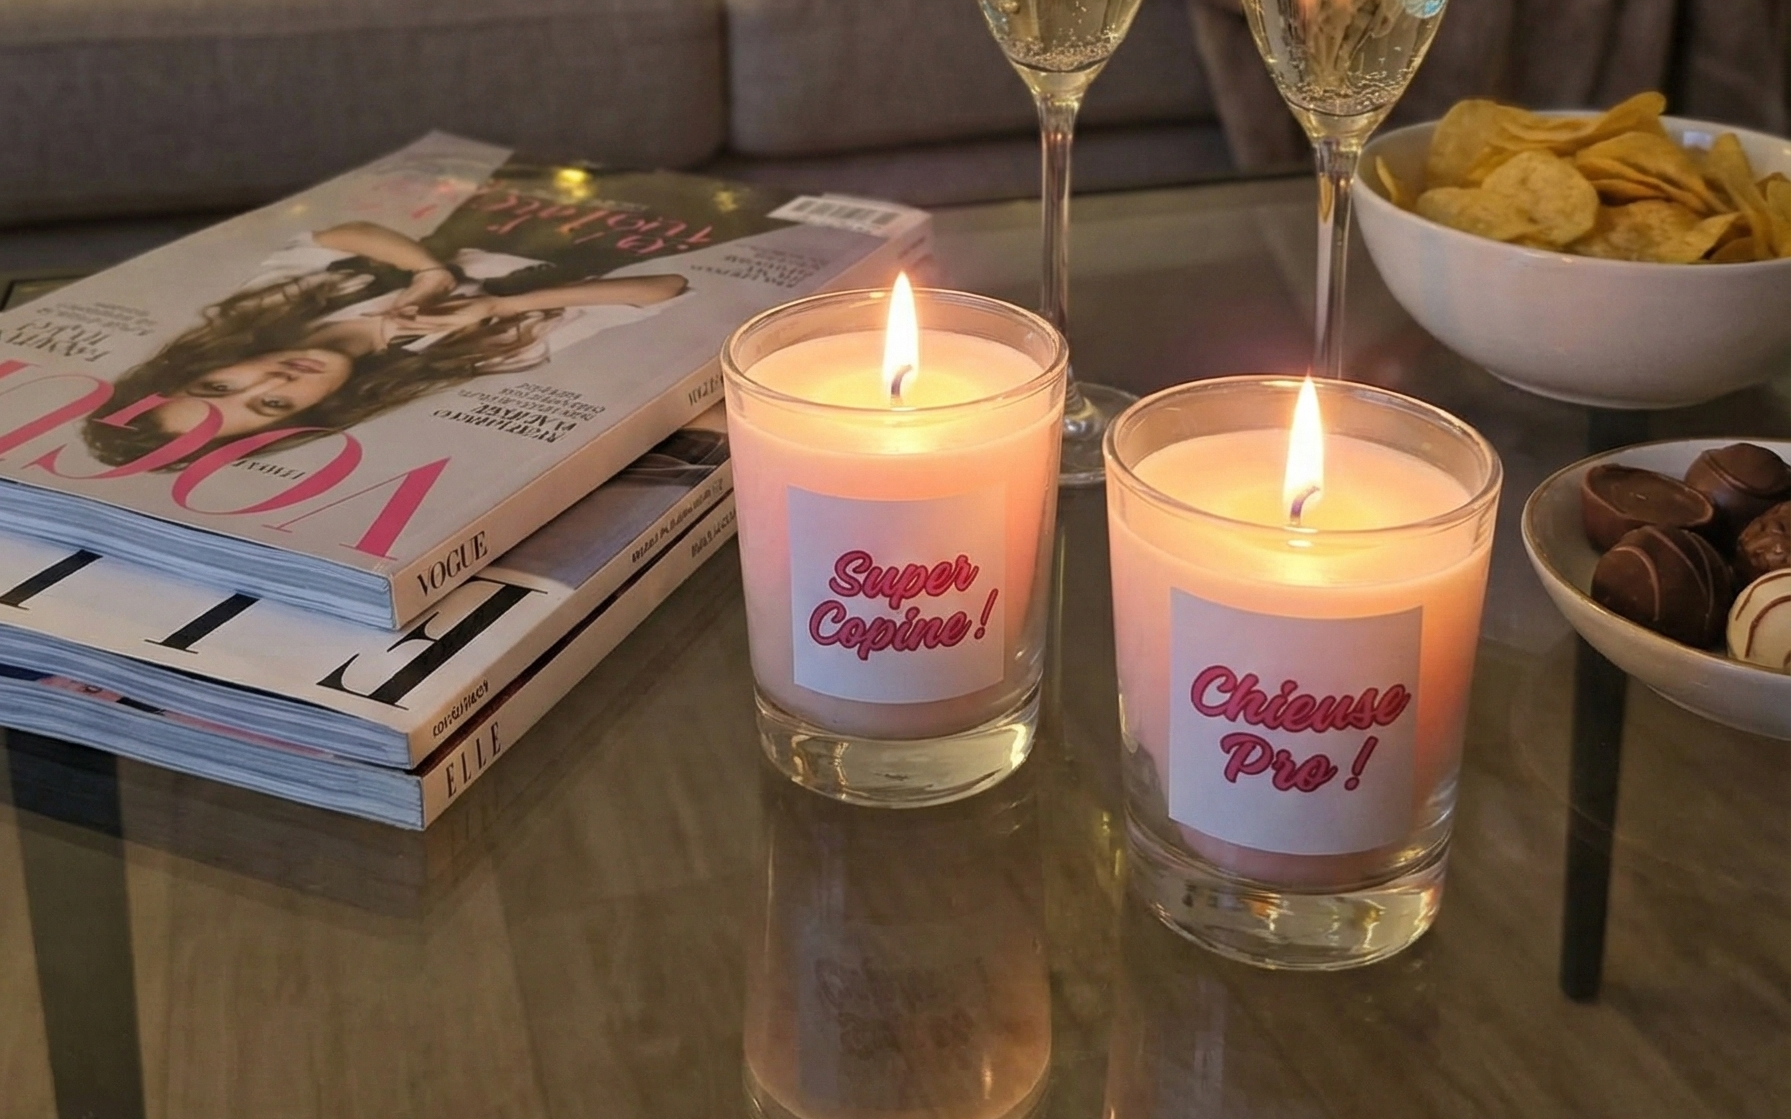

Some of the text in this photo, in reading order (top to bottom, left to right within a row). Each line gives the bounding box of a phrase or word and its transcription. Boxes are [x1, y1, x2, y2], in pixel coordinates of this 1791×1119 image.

[0, 359, 452, 561] VOGU
[416, 530, 489, 597] VOGUE
[828, 550, 979, 610] Super
[1190, 665, 1411, 733] Chieuse
[445, 721, 502, 799] ELLE
